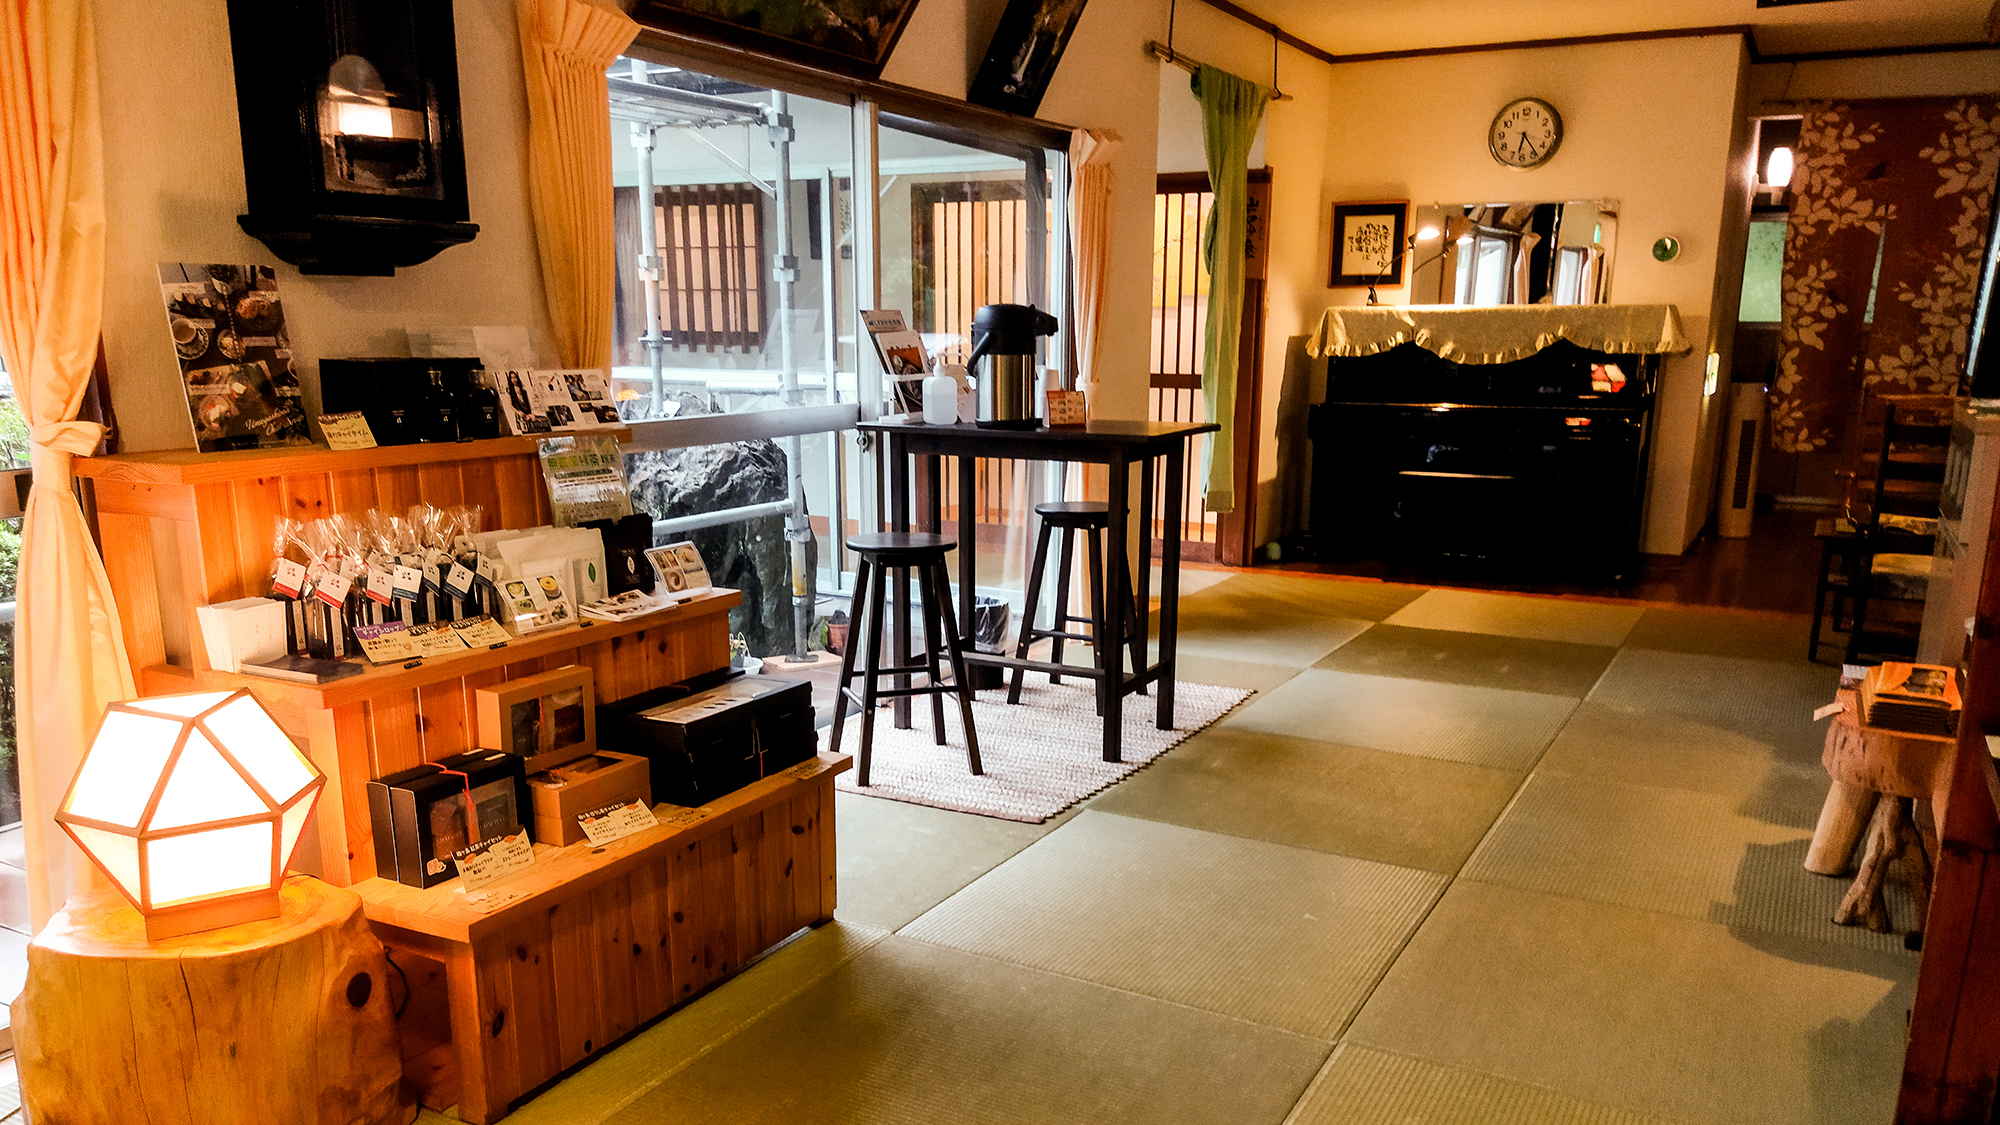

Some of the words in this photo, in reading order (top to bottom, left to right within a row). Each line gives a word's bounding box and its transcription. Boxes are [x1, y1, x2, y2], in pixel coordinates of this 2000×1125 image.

[1512, 112, 1519, 120] 11
[1523, 107, 1531, 116] 12
[1504, 120, 1512, 128] 10
[1542, 117, 1548, 127] 2
[1498, 131, 1505, 140] 9
[1544, 129, 1551, 138] 3
[1501, 142, 1507, 151] 8
[1540, 141, 1545, 149] 4
[1510, 150, 1516, 159] 7
[1519, 153, 1525, 162] 6
